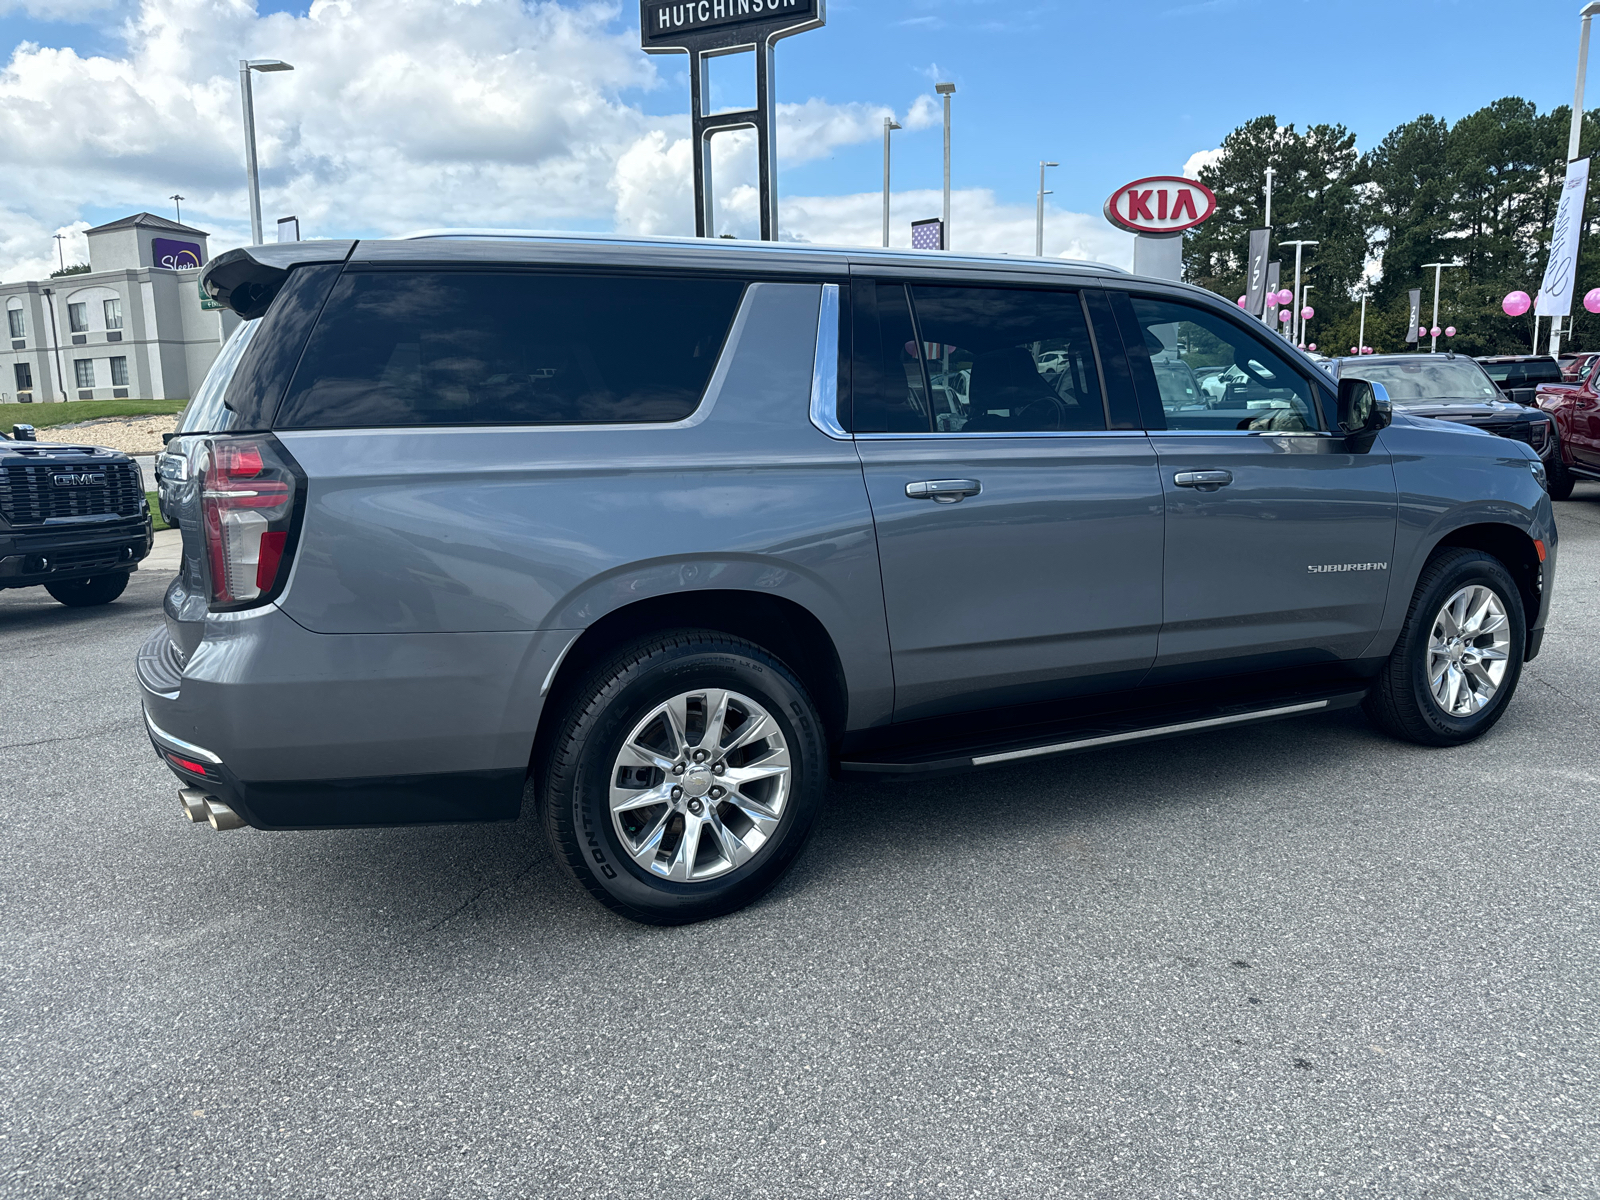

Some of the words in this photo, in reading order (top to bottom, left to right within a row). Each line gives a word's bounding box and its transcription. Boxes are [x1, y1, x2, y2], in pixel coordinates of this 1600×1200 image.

[1127, 189, 1198, 220] KIA
[53, 473, 105, 486] GMC
[1307, 562, 1387, 574] SUBURBAN
